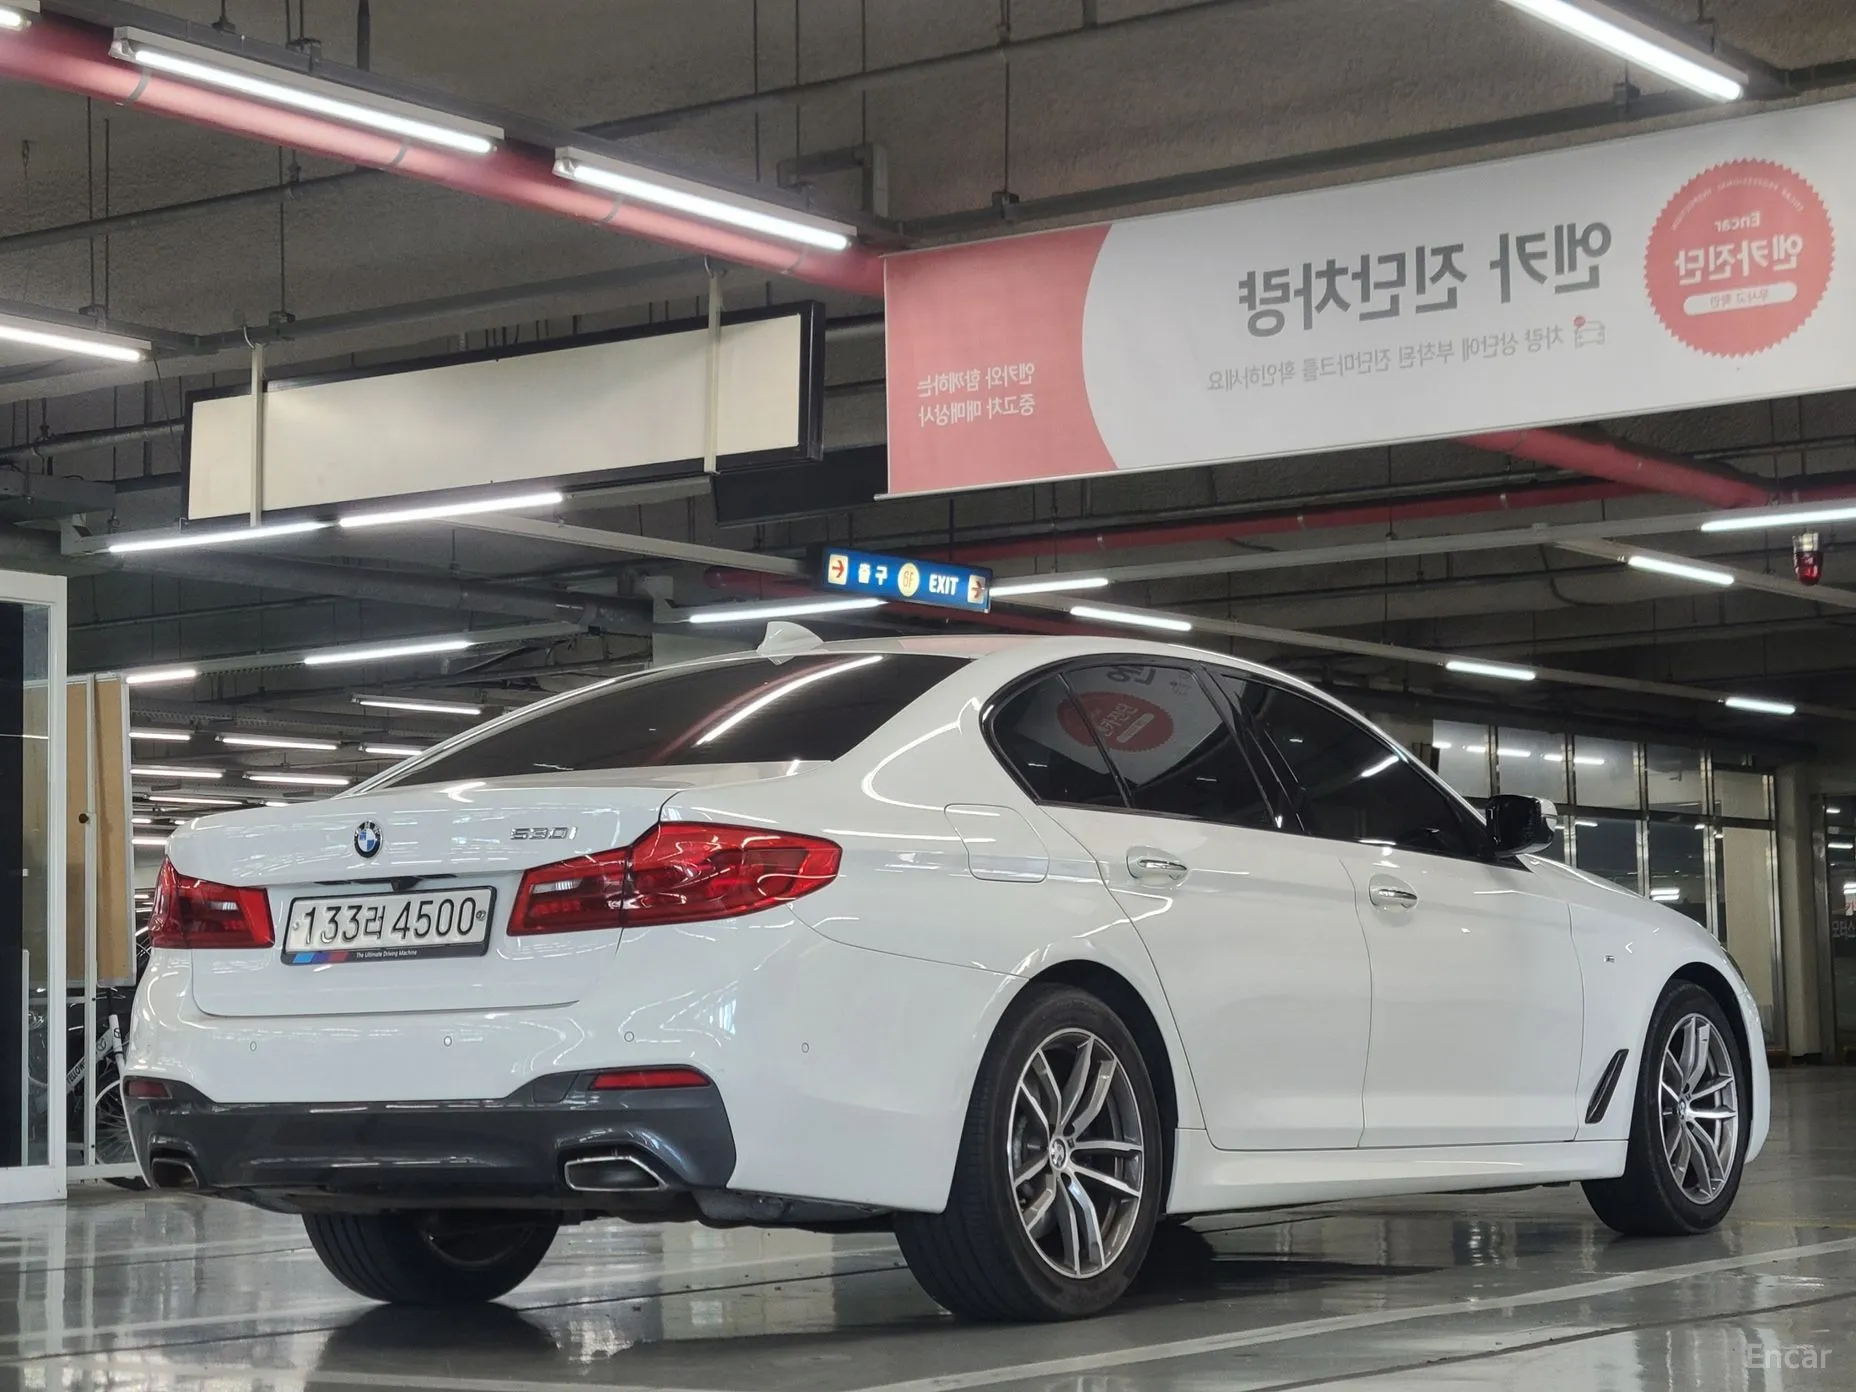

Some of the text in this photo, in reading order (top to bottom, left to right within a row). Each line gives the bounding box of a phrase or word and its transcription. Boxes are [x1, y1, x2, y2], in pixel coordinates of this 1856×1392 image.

[928, 574, 959, 595] EXIT
[304, 897, 476, 945] 133러 4500
